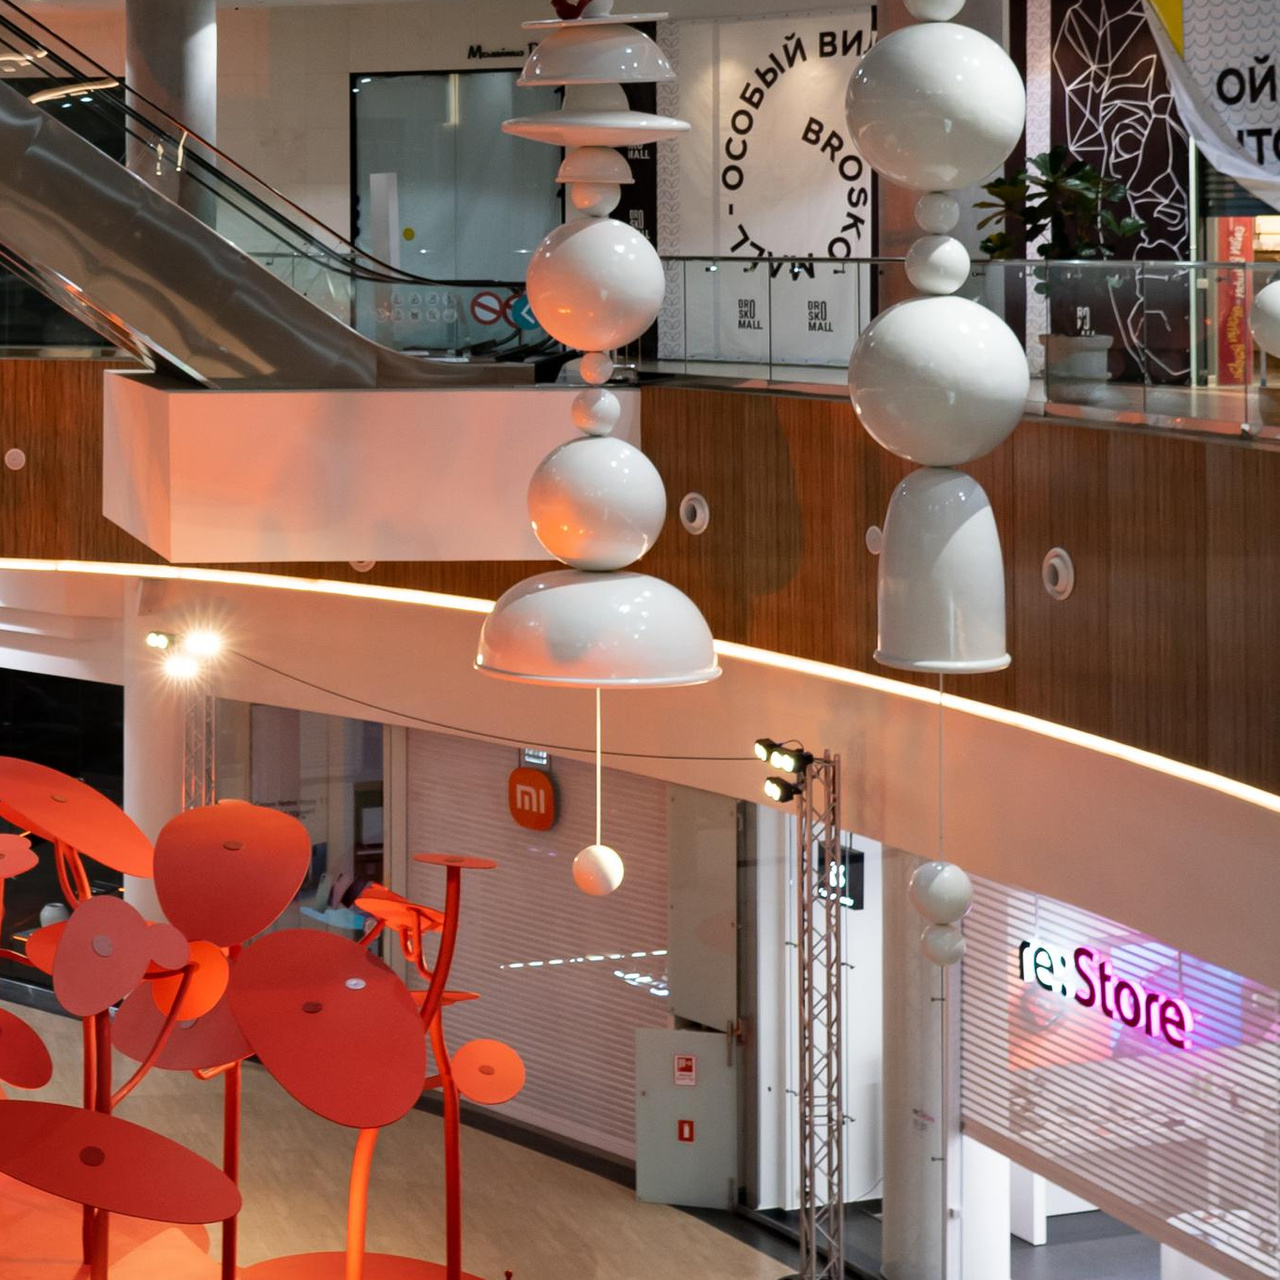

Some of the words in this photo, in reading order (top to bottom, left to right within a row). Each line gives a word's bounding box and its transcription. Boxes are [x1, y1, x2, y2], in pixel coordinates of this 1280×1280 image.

[721, 32, 808, 191] ОСОБЫЙ
[801, 116, 868, 259] BROSKO
[1019, 939, 1194, 1050] re:Store
